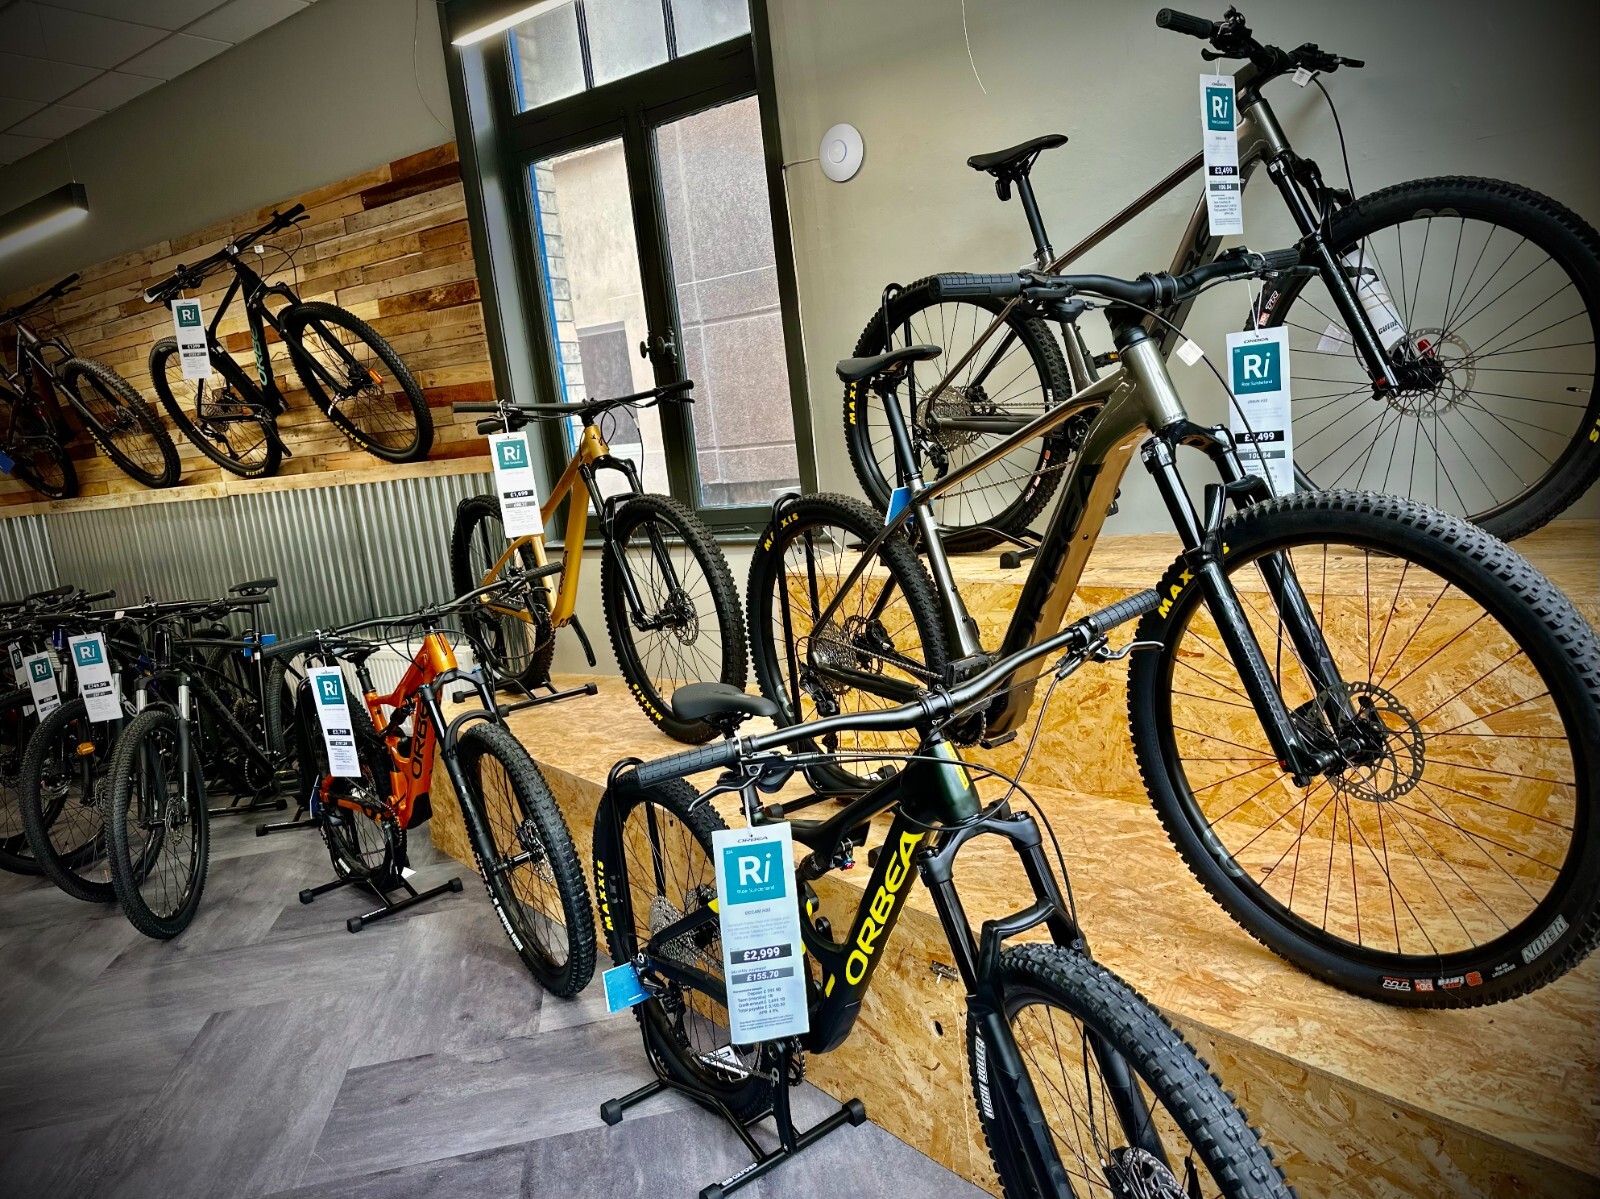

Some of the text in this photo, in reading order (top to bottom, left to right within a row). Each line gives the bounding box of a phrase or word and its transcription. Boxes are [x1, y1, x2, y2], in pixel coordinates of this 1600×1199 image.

[1212, 96, 1228, 118] Ri
[1215, 167, 1233, 175] £3,499
[182, 309, 194, 320] Ri
[1244, 352, 1270, 379] Ri
[503, 445, 520, 461] Ri
[80, 645, 95, 659] Ri
[35, 663, 46, 676] Ri
[322, 680, 338, 696] Ri
[412, 701, 430, 780] ORBE
[738, 853, 772, 886] Ri
[597, 860, 613, 931] MAXXIS
[846, 831, 925, 985] ORBEA
[1521, 914, 1569, 964] REKON
[743, 947, 780, 961] £2,999
[747, 970, 779, 981] £155.70
[979, 1082, 995, 1120] HIGH
